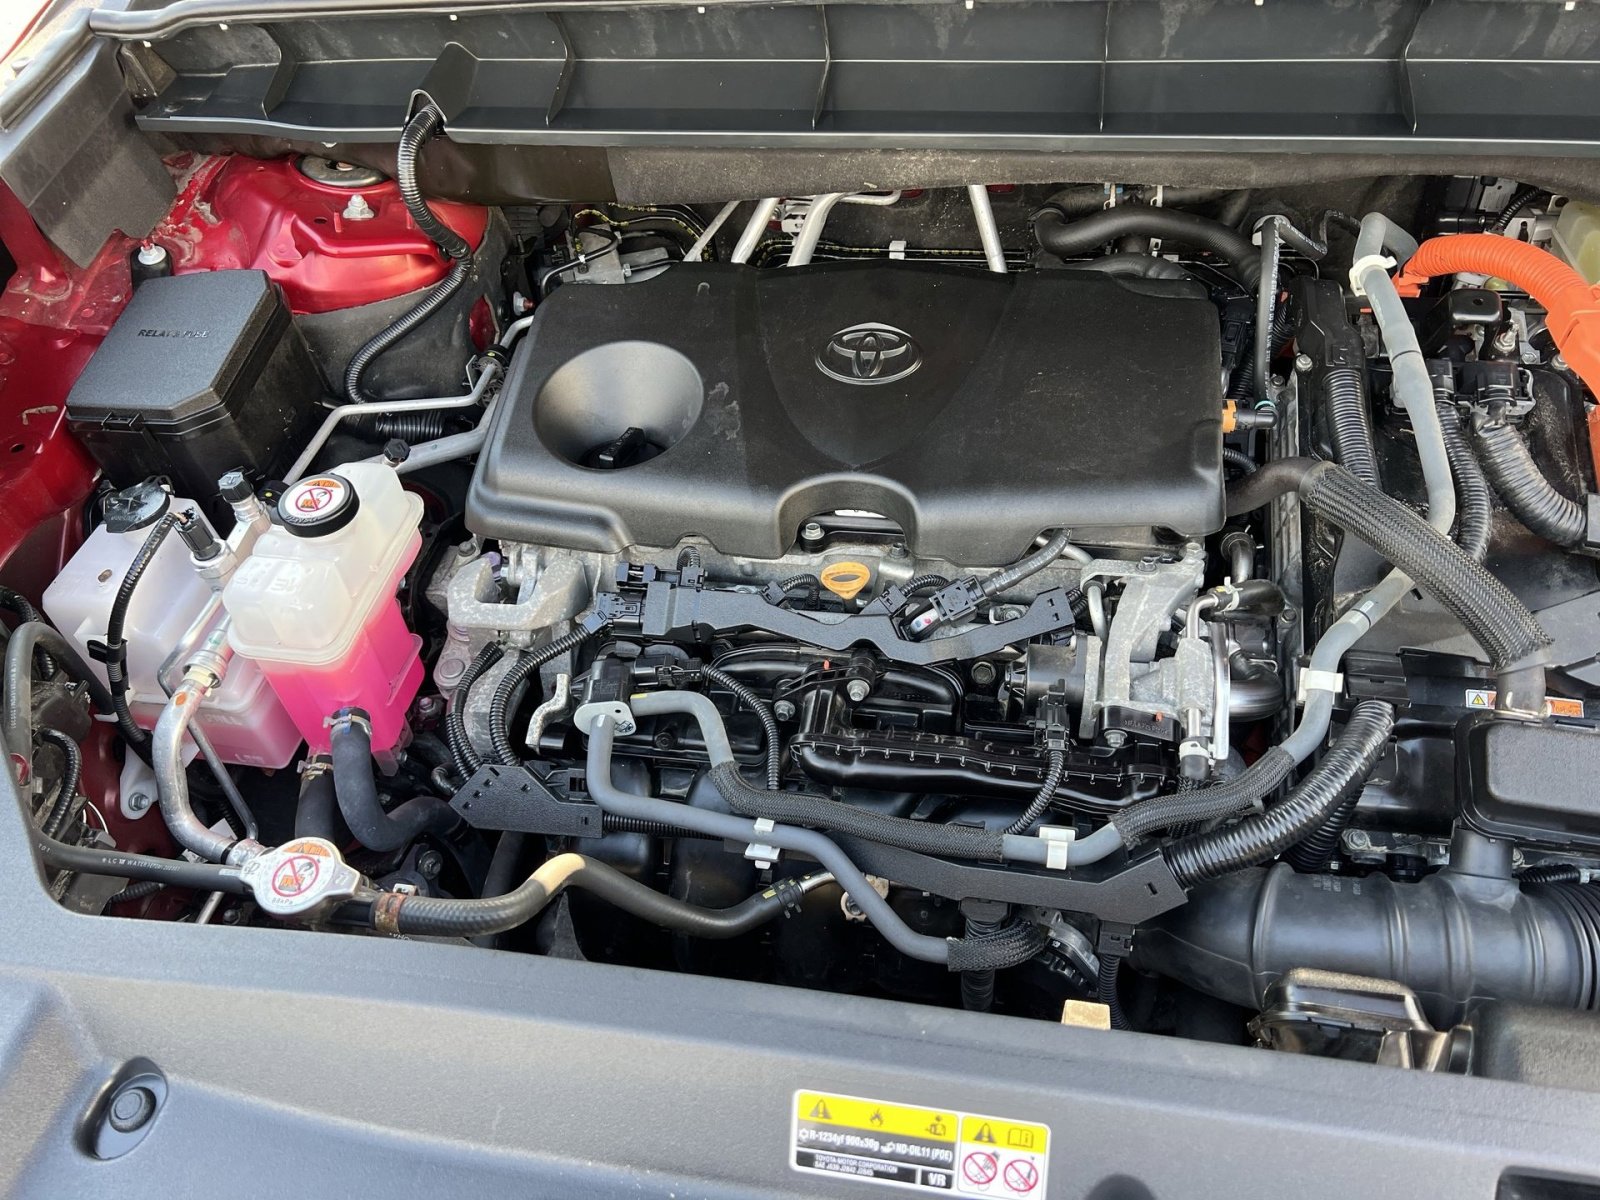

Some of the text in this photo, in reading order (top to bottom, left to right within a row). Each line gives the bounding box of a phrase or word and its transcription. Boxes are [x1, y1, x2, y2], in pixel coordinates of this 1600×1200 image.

[809, 1129, 845, 1147] R-1234yf
[931, 1147, 954, 1164] (POE)
[814, 1153, 899, 1174] TOYOTA MOTOR CORPORATION
[927, 1172, 947, 1187] VR
